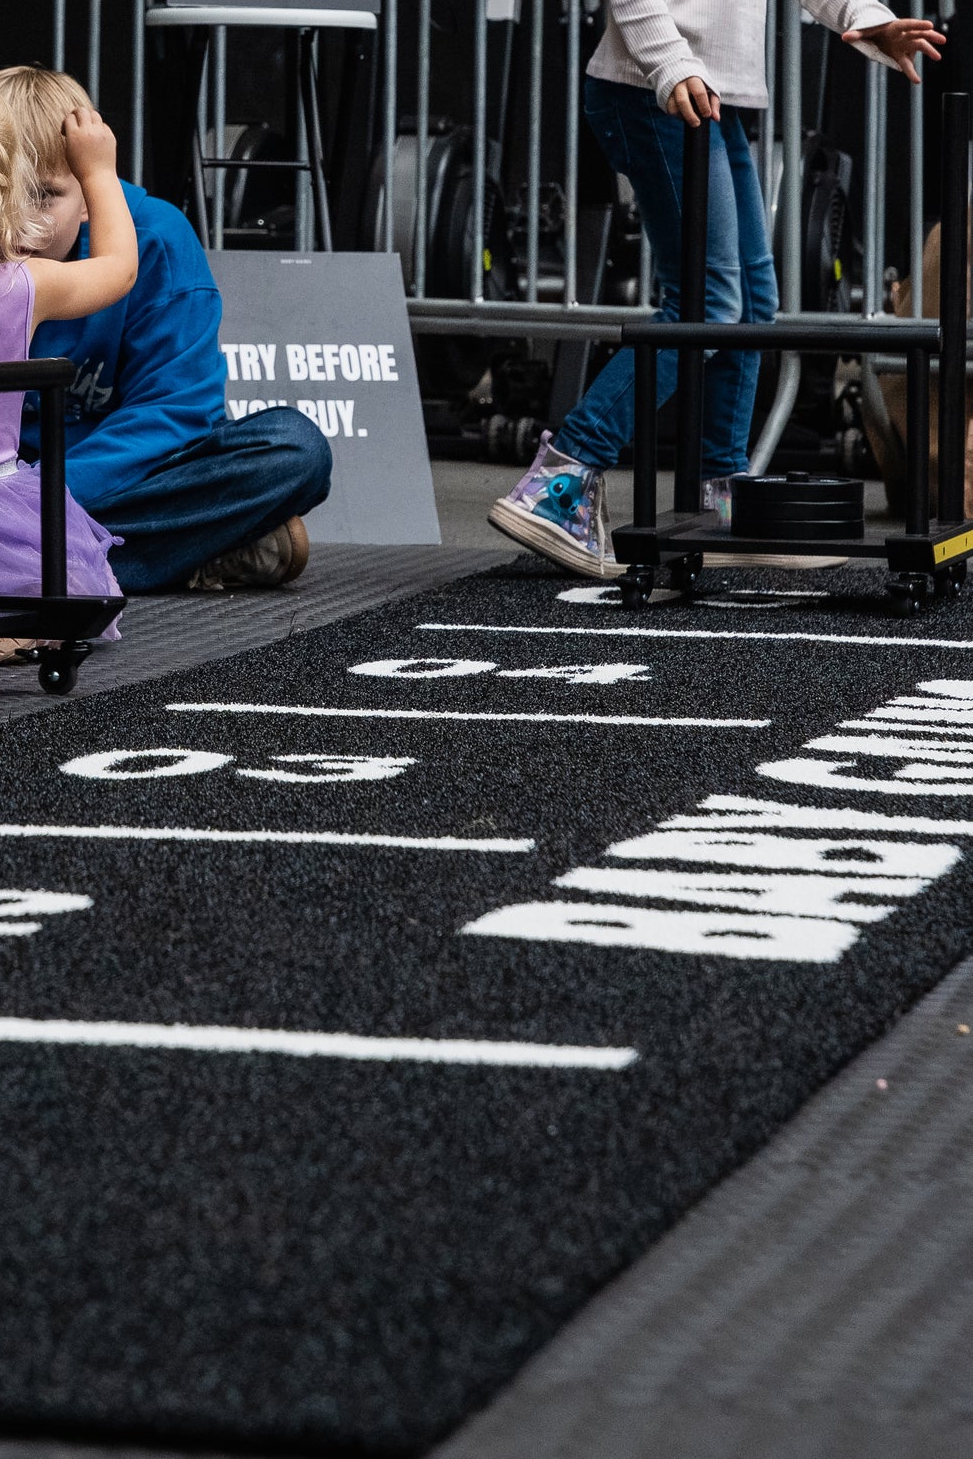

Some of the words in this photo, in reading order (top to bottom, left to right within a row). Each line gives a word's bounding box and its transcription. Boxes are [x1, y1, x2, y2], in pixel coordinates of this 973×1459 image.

[221, 344, 277, 381] TRY
[285, 344, 399, 381] BEFORE
[347, 658, 653, 684] 04
[59, 748, 420, 783] 03
[461, 794, 973, 965] BABY
